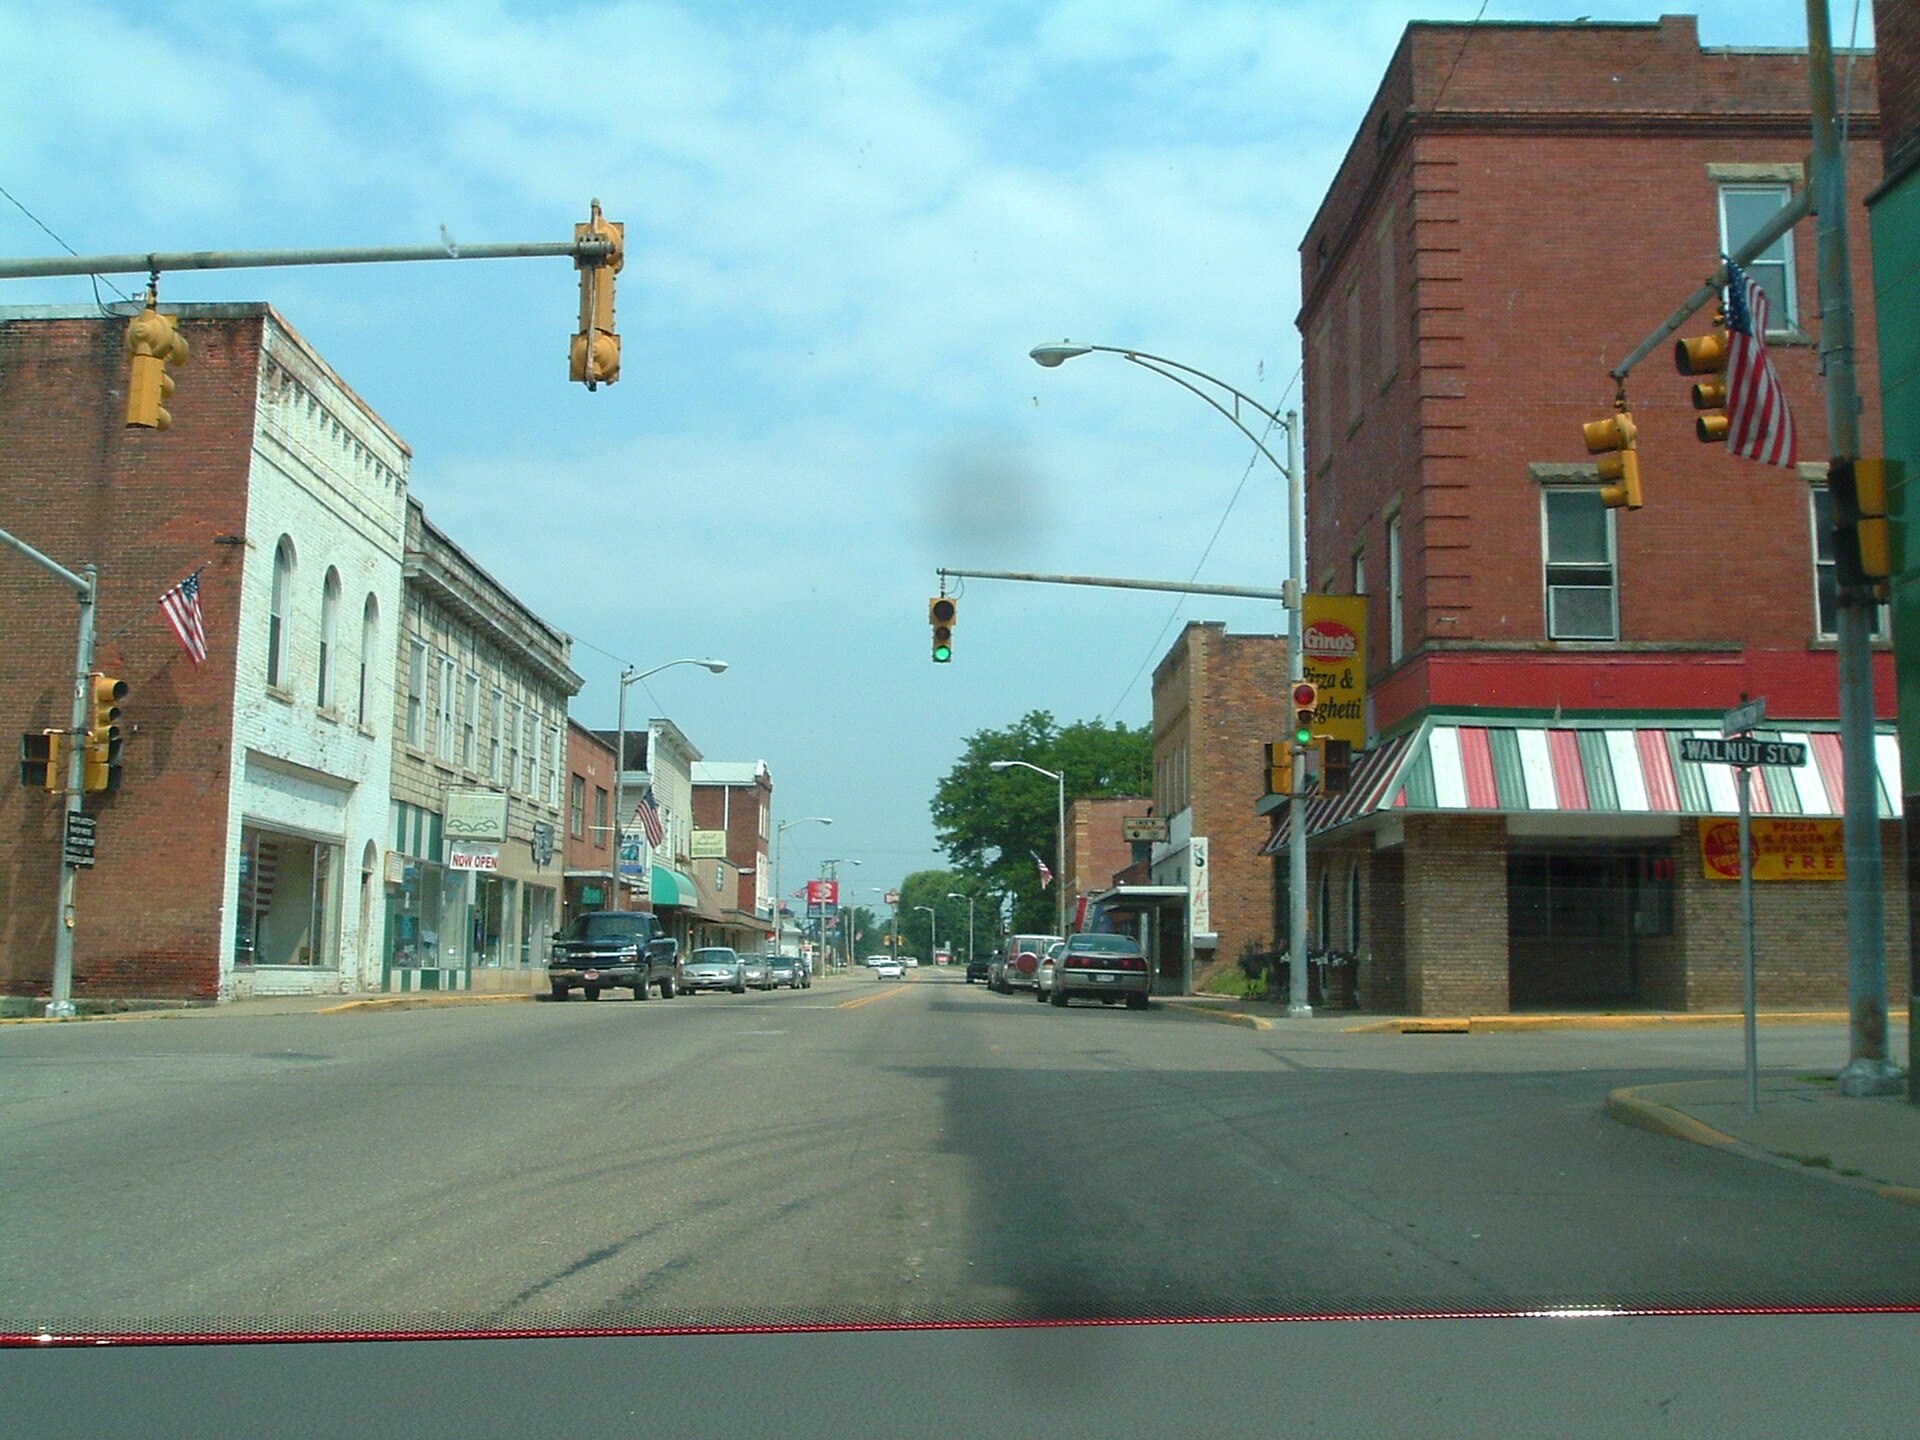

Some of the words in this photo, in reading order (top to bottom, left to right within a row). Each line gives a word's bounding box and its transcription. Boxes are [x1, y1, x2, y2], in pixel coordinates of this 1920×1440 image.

[1303, 627, 1356, 650] Gino's
[1303, 667, 1336, 689] Pizza
[1340, 667, 1353, 689] &
[1314, 697, 1361, 724] ghetti
[1686, 741, 1762, 763] WALNUT
[1766, 743, 1789, 764] ST
[1772, 822, 1818, 832] PIZZA
[452, 854, 473, 867] NOW
[474, 856, 498, 869] OPEN
[1784, 855, 1836, 869] FRE
